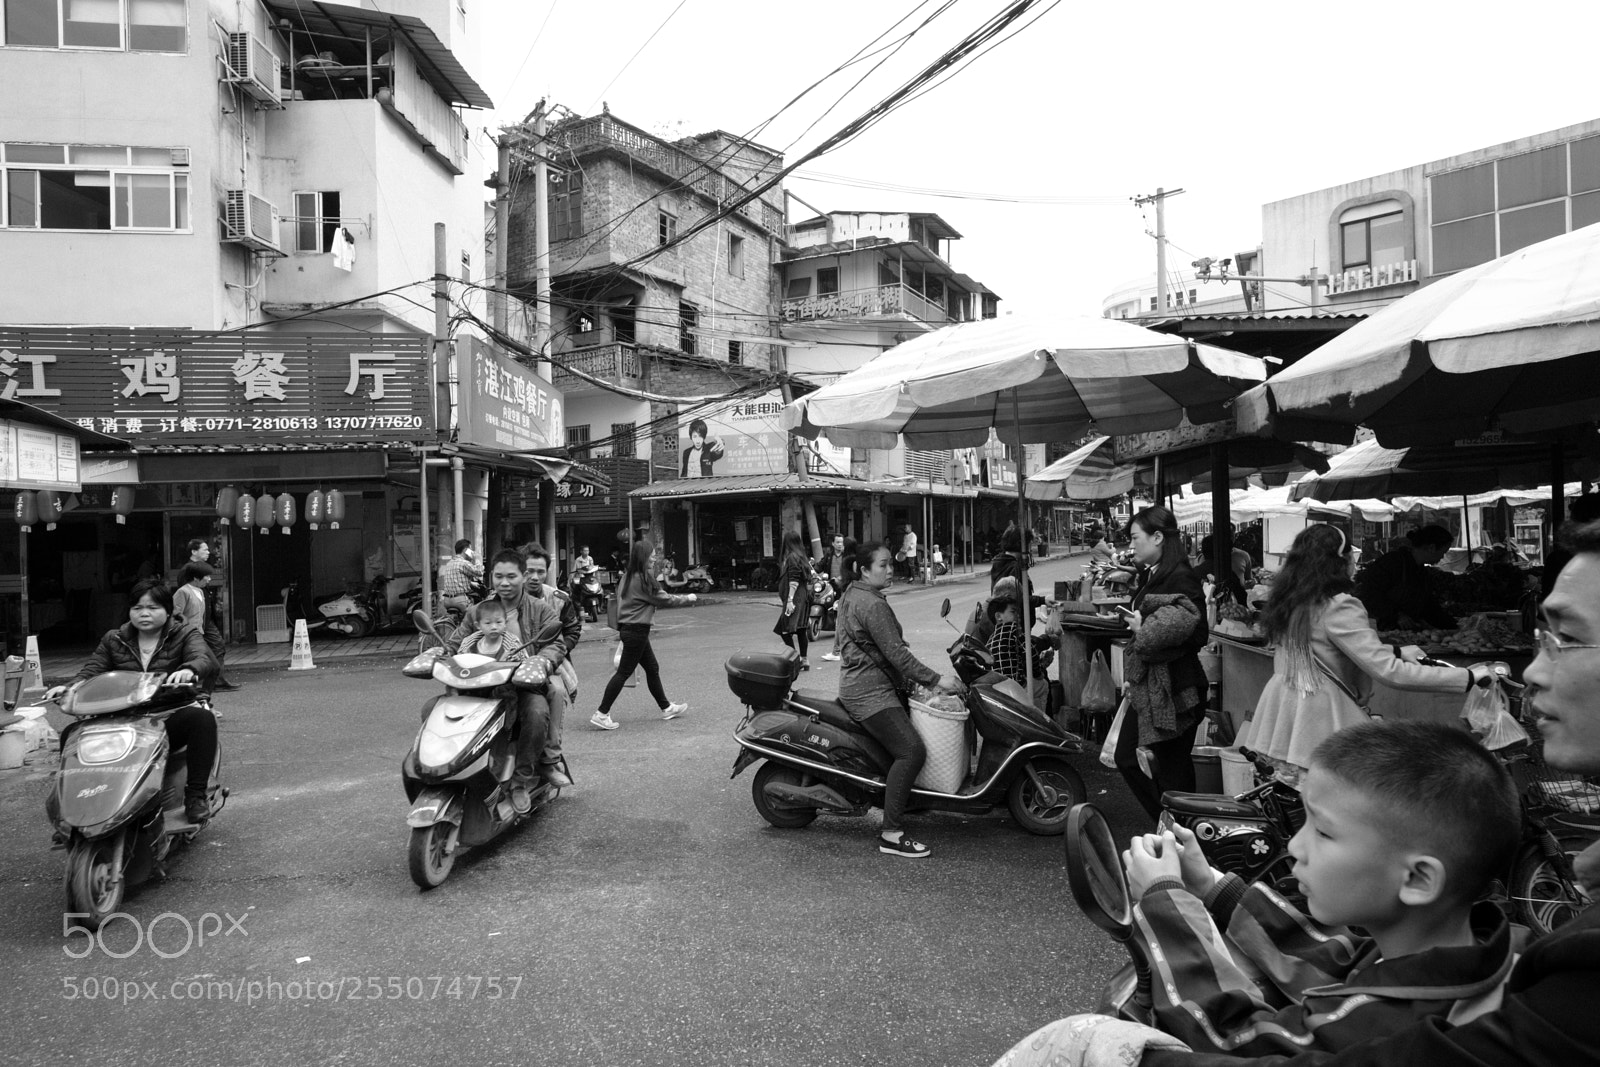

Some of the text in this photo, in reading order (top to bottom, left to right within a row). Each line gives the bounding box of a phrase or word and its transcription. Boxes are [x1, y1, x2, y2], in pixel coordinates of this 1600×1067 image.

[0, 350, 398, 402] 江鸡餐厅
[484, 357, 547, 421] 湛江鸡餐厅
[324, 416, 423, 430] 13707717620
[732, 402, 784, 417] 天能电池
